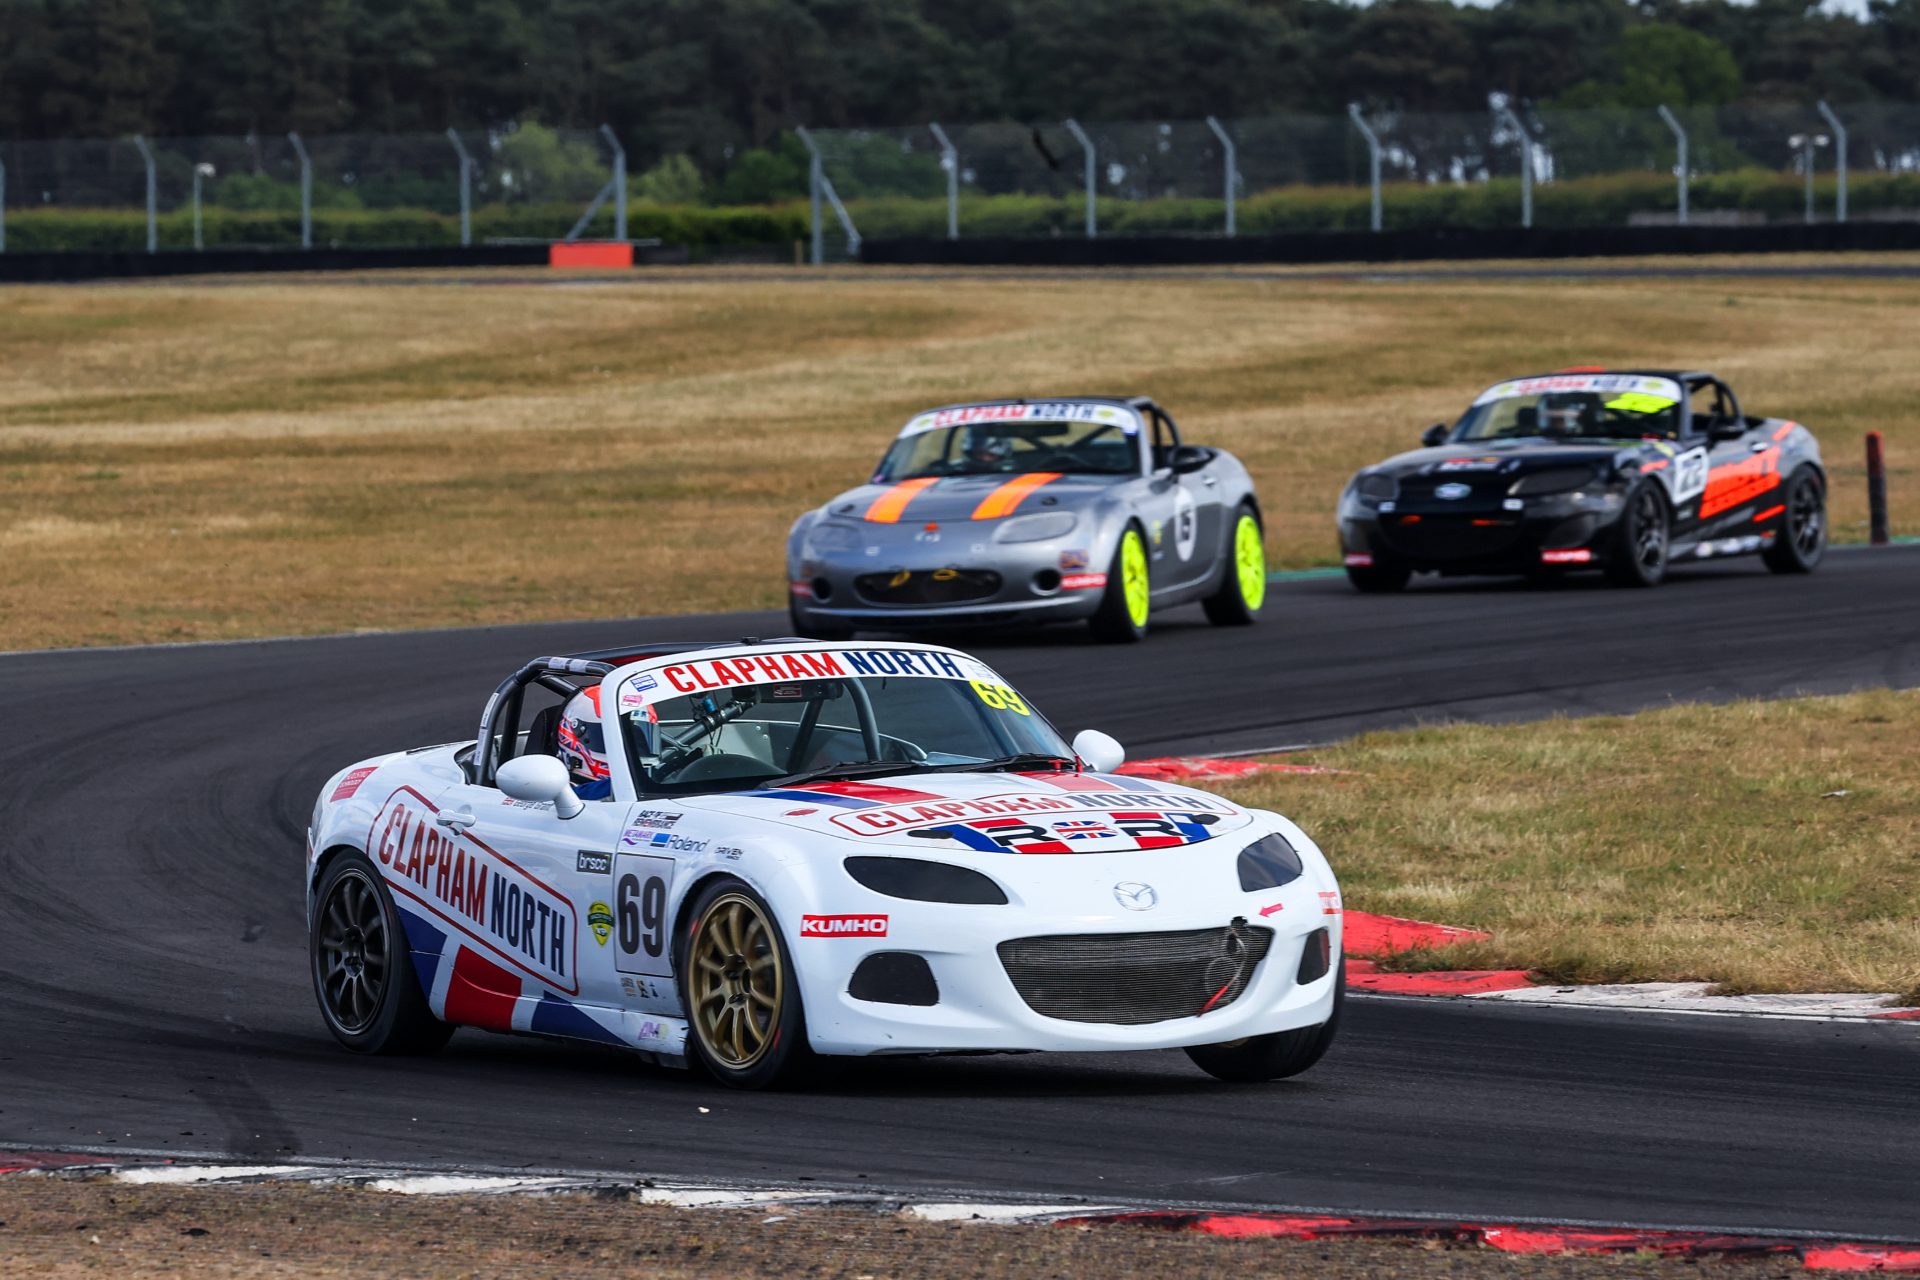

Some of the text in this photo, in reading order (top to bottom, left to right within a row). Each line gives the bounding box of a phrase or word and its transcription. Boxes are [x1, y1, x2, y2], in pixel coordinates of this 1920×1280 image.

[934, 403, 1096, 427] CLAPHAM NORTH
[663, 652, 846, 692] CLAPHAM
[841, 650, 966, 679] NORTH
[969, 680, 1031, 716] 69
[856, 794, 1215, 828] CLAPHAM NORTH
[668, 834, 711, 853] Roland
[579, 853, 607, 872] brscc
[379, 803, 566, 977] CLAPHAM NORTH
[617, 873, 666, 958] 69
[802, 919, 887, 933] KUMHO
